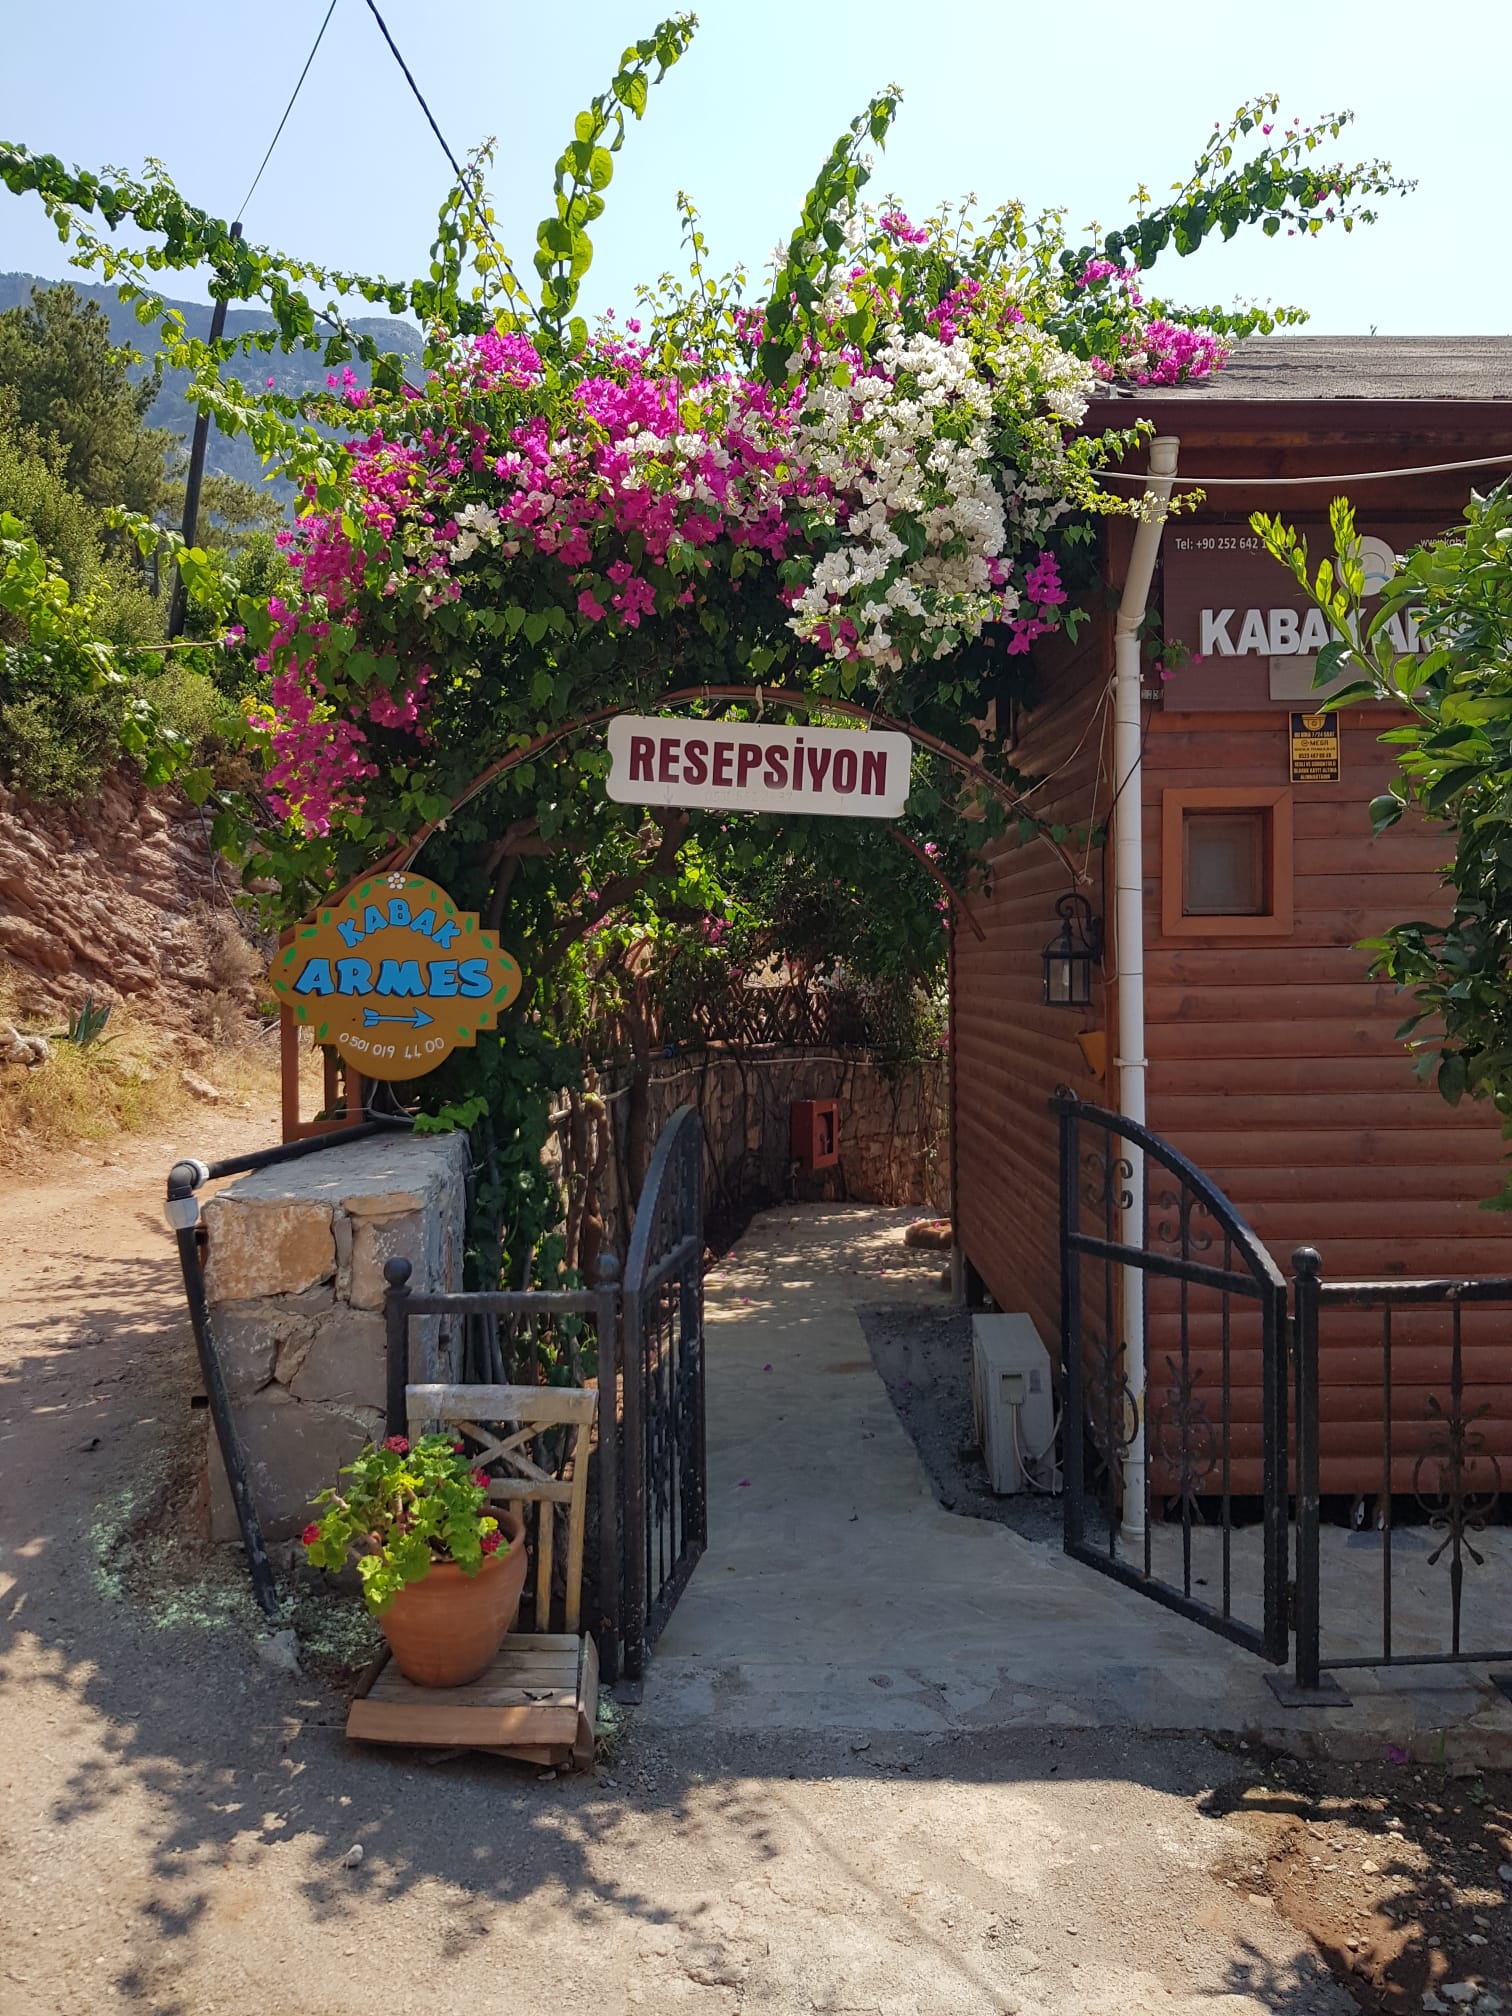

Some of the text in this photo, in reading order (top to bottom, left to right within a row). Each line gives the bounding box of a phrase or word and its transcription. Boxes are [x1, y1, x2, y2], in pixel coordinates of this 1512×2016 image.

[1175, 538, 1194, 550] Tel:
[1196, 538, 1215, 550] +90
[1217, 537, 1236, 549] 252
[1239, 537, 1259, 549] 642
[629, 736, 887, 796] RESEPSİYON
[337, 898, 462, 949] KABAK
[293, 957, 494, 998] ARMES
[372, 1043, 396, 1059] 019
[425, 1037, 446, 1053] 00
